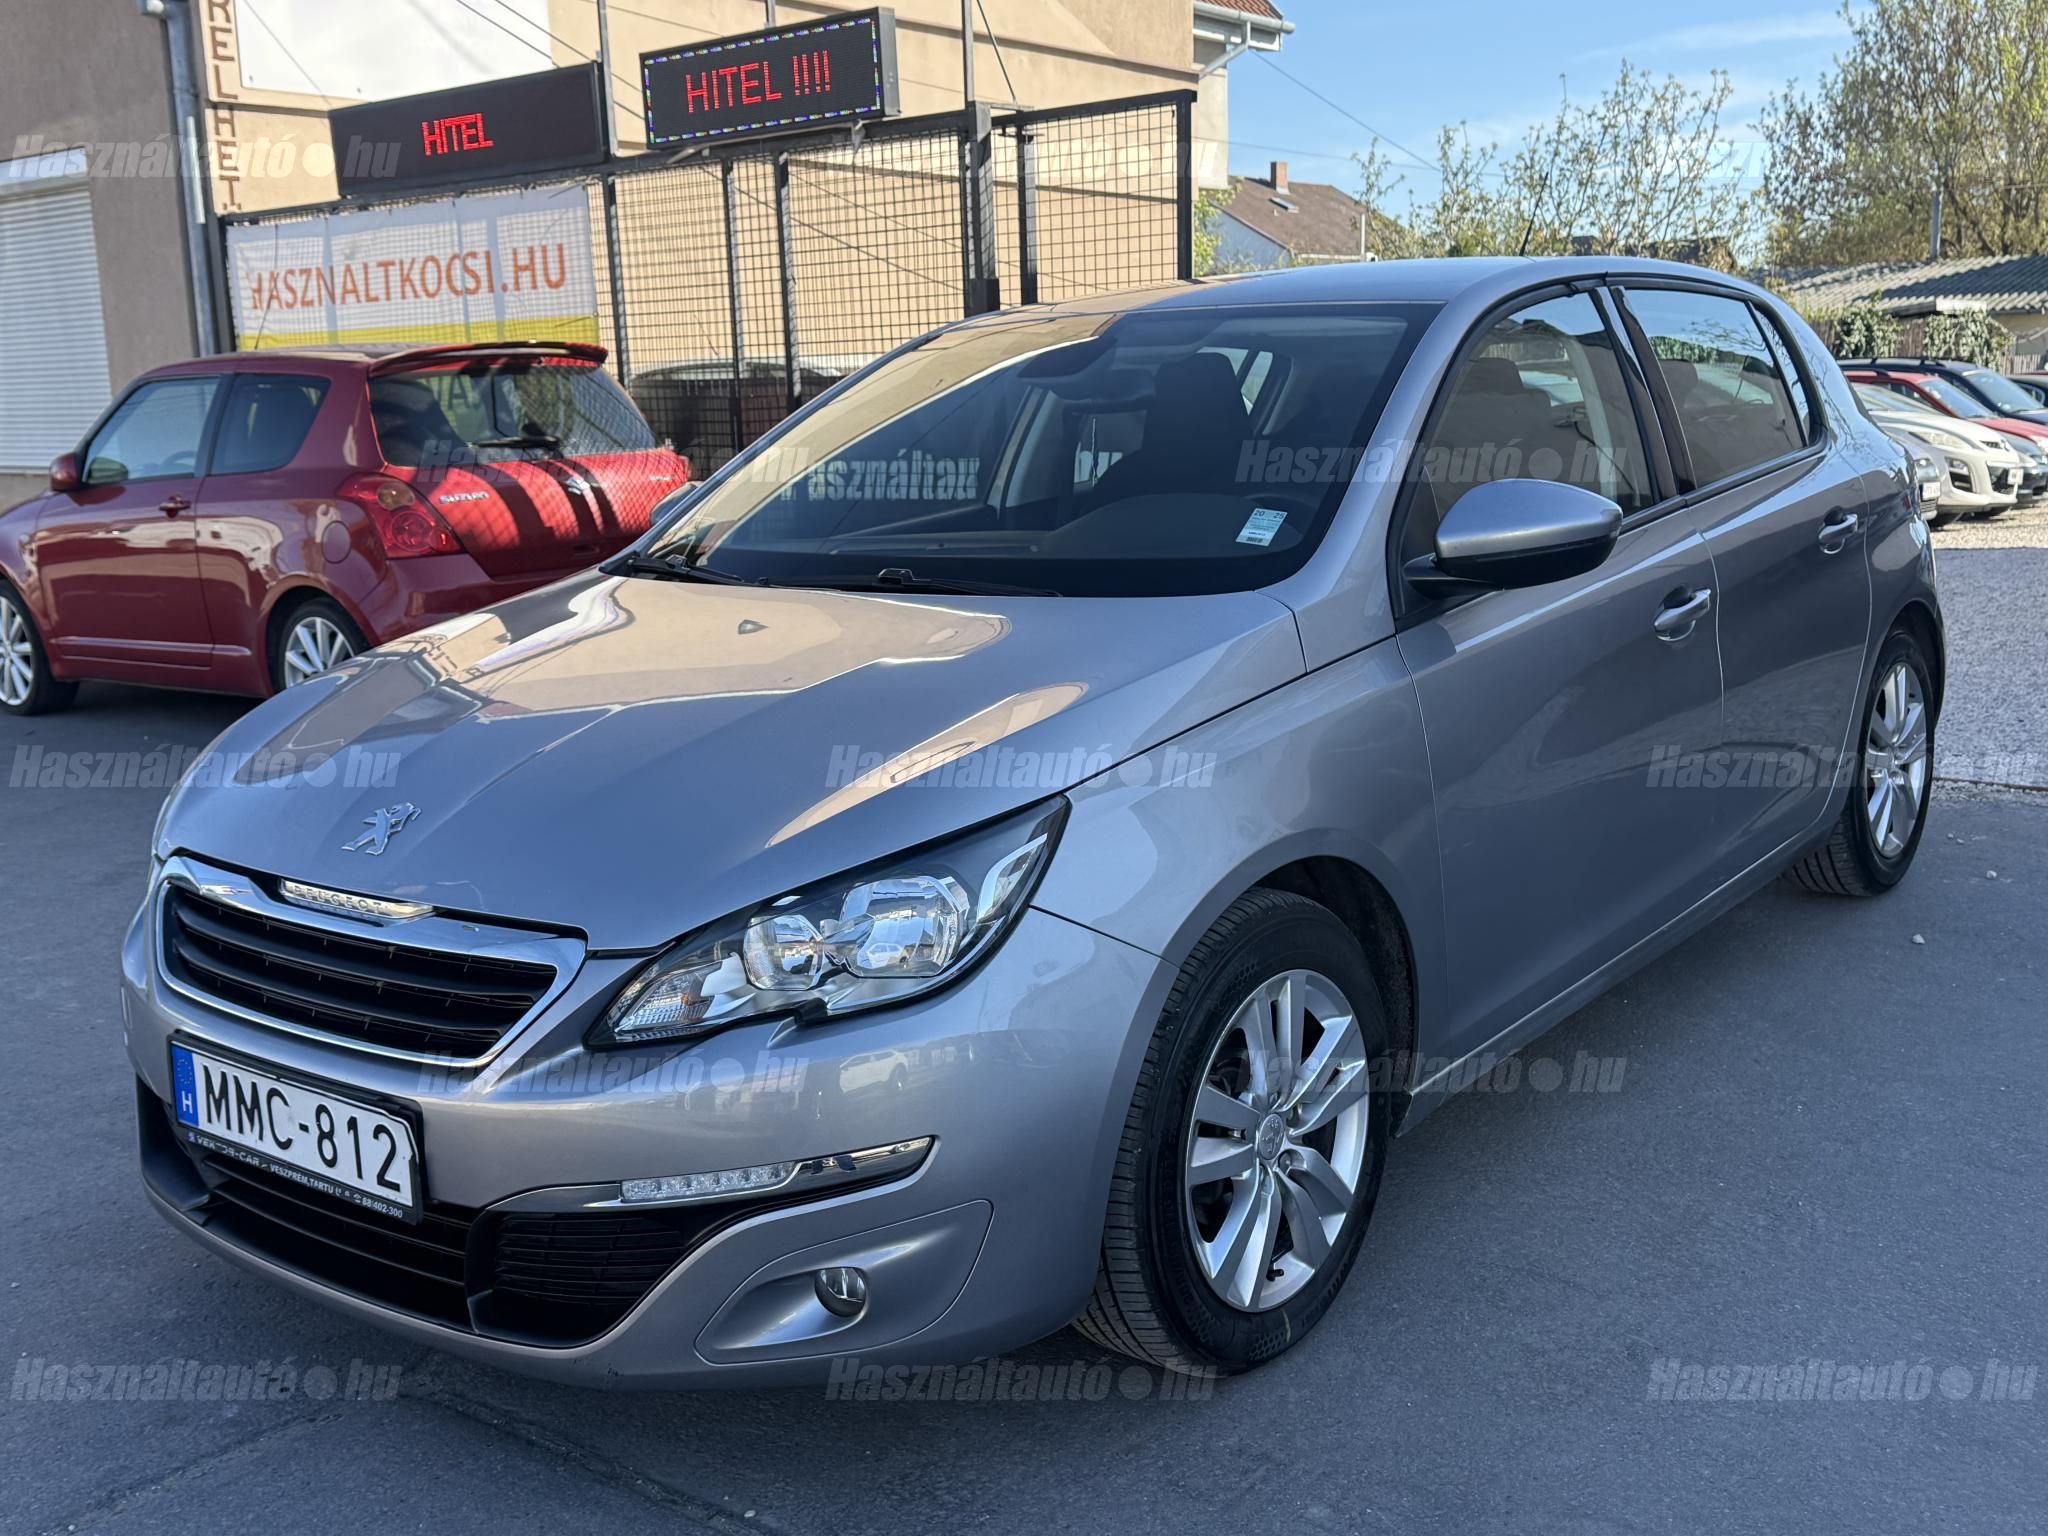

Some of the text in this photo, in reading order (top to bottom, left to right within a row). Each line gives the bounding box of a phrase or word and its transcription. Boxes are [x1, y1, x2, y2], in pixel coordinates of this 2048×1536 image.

[685, 49, 832, 113] HITEL !!!!
[421, 112, 494, 156] HITEL
[294, 885, 384, 914] PEUGEOT
[181, 1063, 401, 1193] H MMC-812
